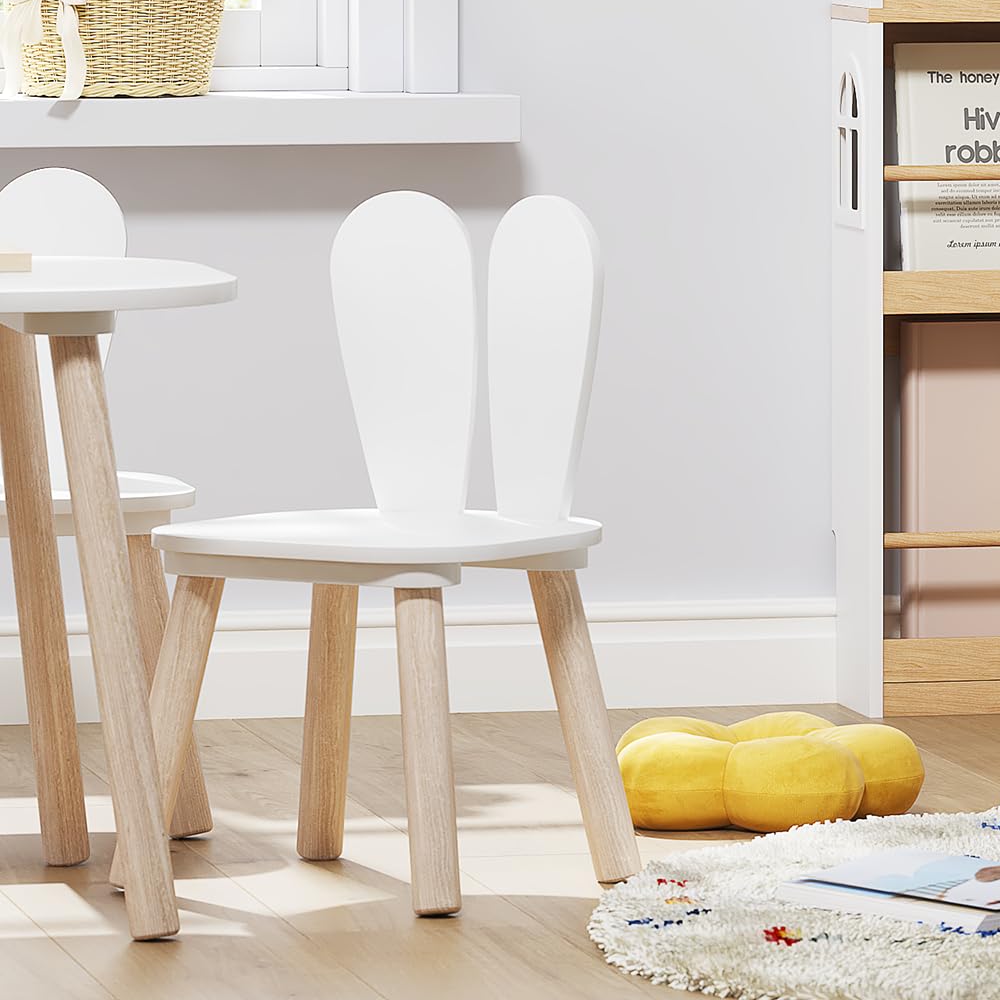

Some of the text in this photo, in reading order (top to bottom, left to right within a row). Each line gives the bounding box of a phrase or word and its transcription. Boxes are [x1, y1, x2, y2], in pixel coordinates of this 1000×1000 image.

[927, 71, 953, 83] The
[960, 71, 1000, 85] honey
[947, 240, 971, 248] Lorem
[974, 239, 997, 249] ipsum
